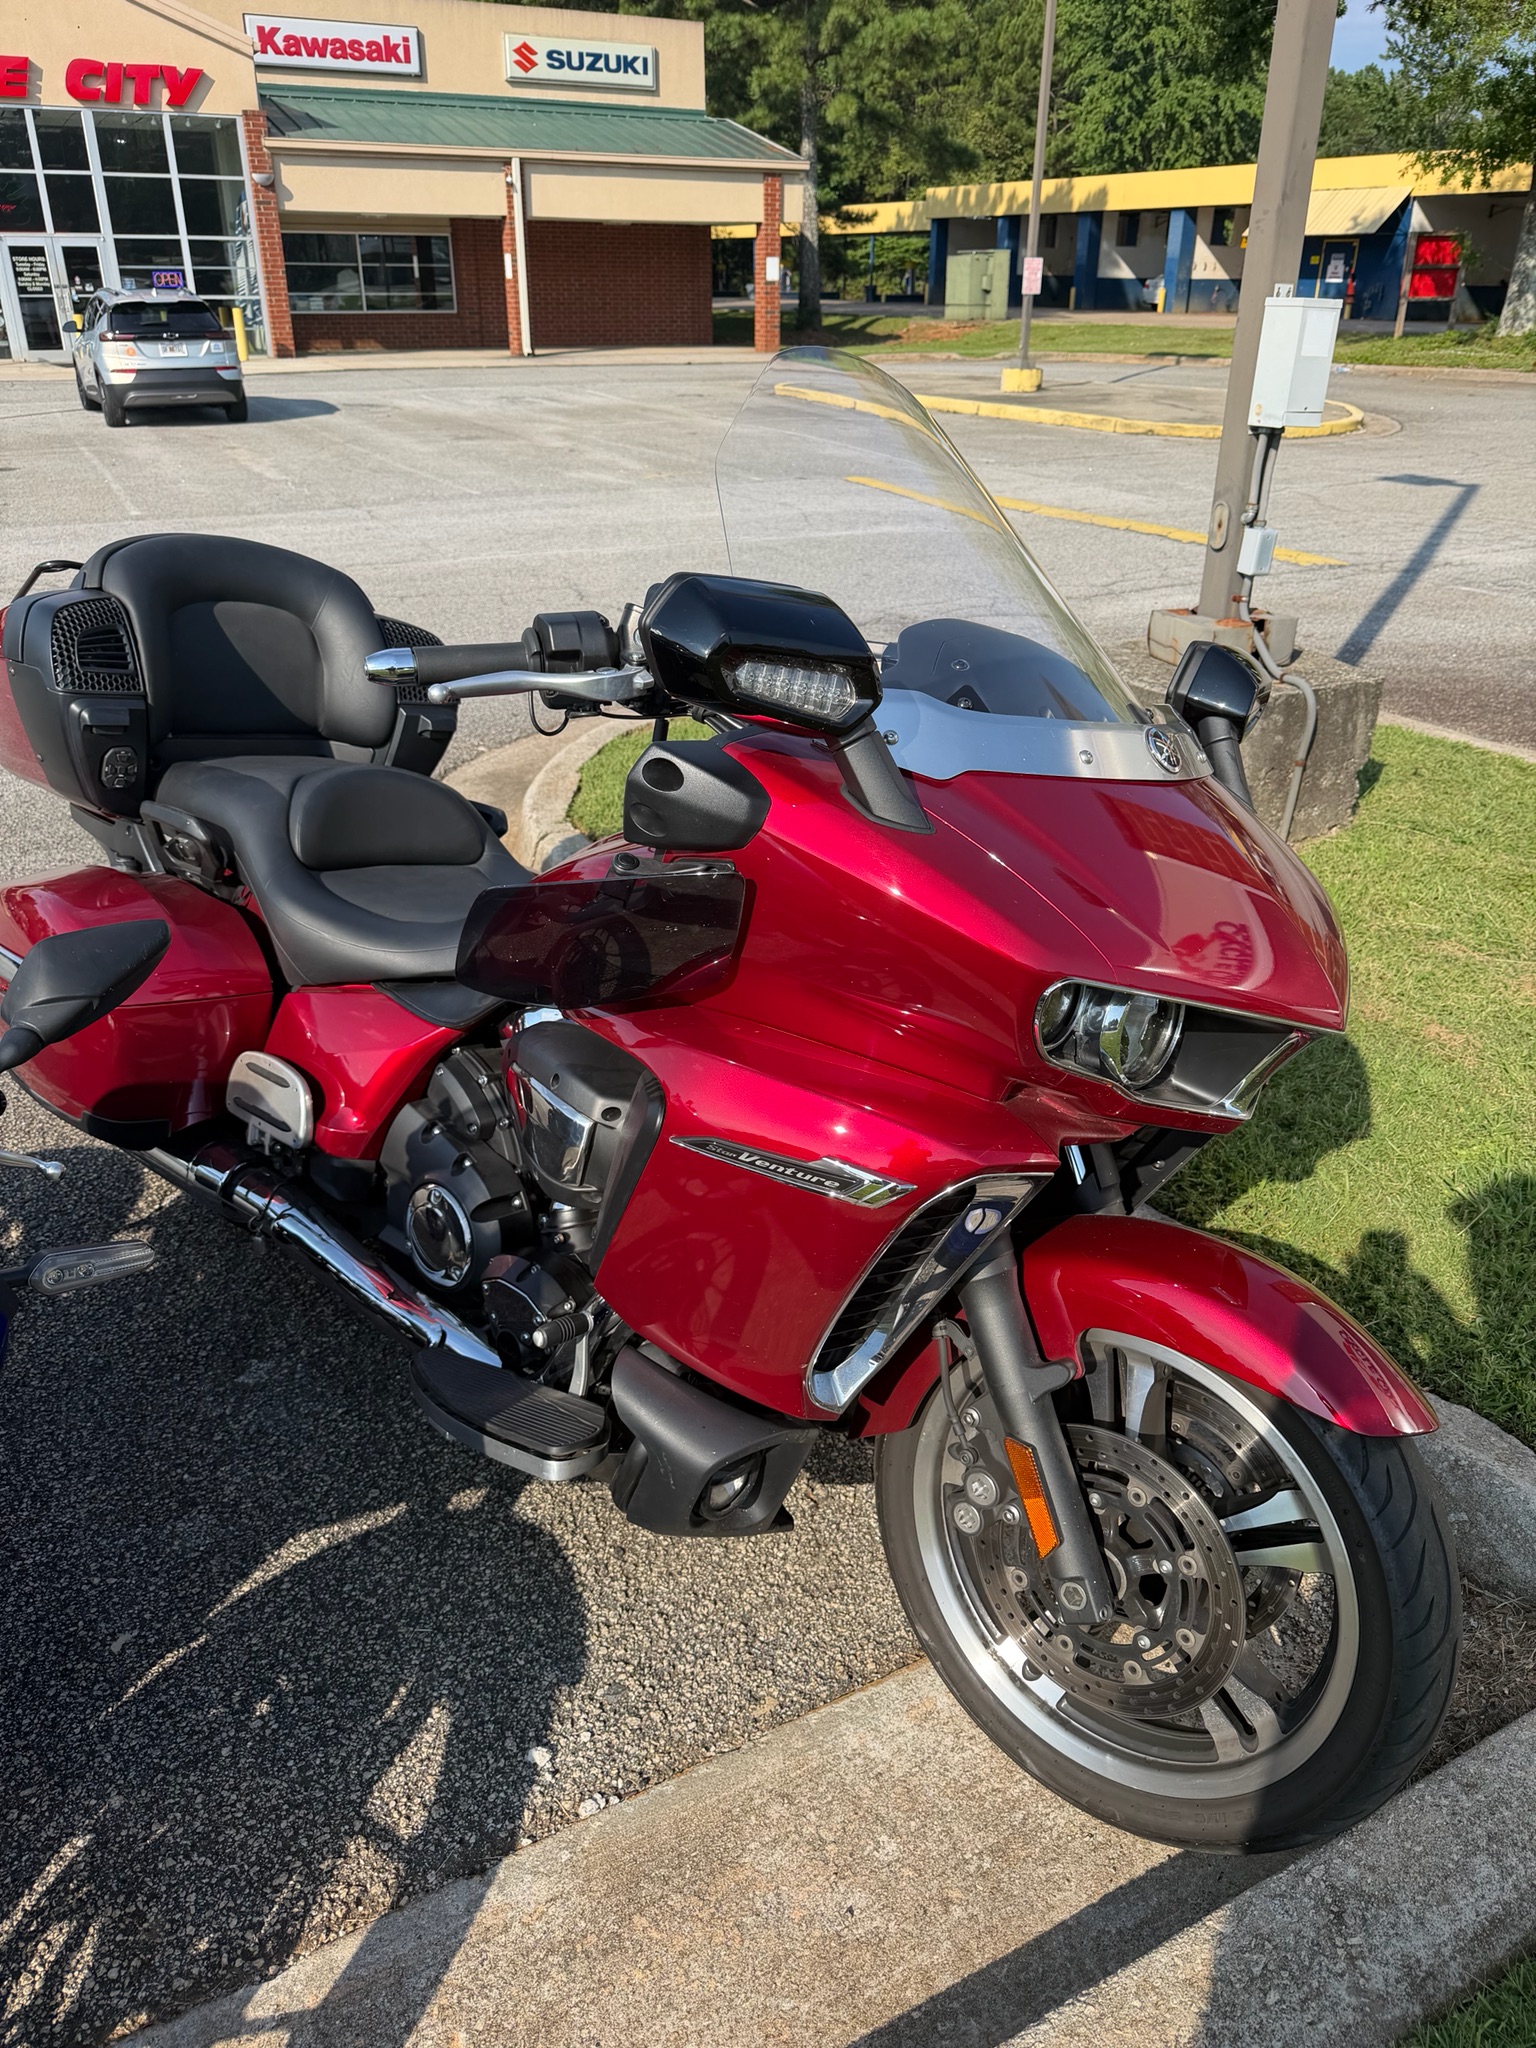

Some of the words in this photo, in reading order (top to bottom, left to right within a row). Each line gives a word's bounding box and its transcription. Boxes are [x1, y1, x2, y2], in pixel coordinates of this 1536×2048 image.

[255, 25, 412, 65] Kawasaki
[545, 49, 649, 76] SUZUKI
[65, 58, 204, 106] CITY
[154, 272, 183, 287] OPEN
[738, 1151, 841, 1188] Venture
